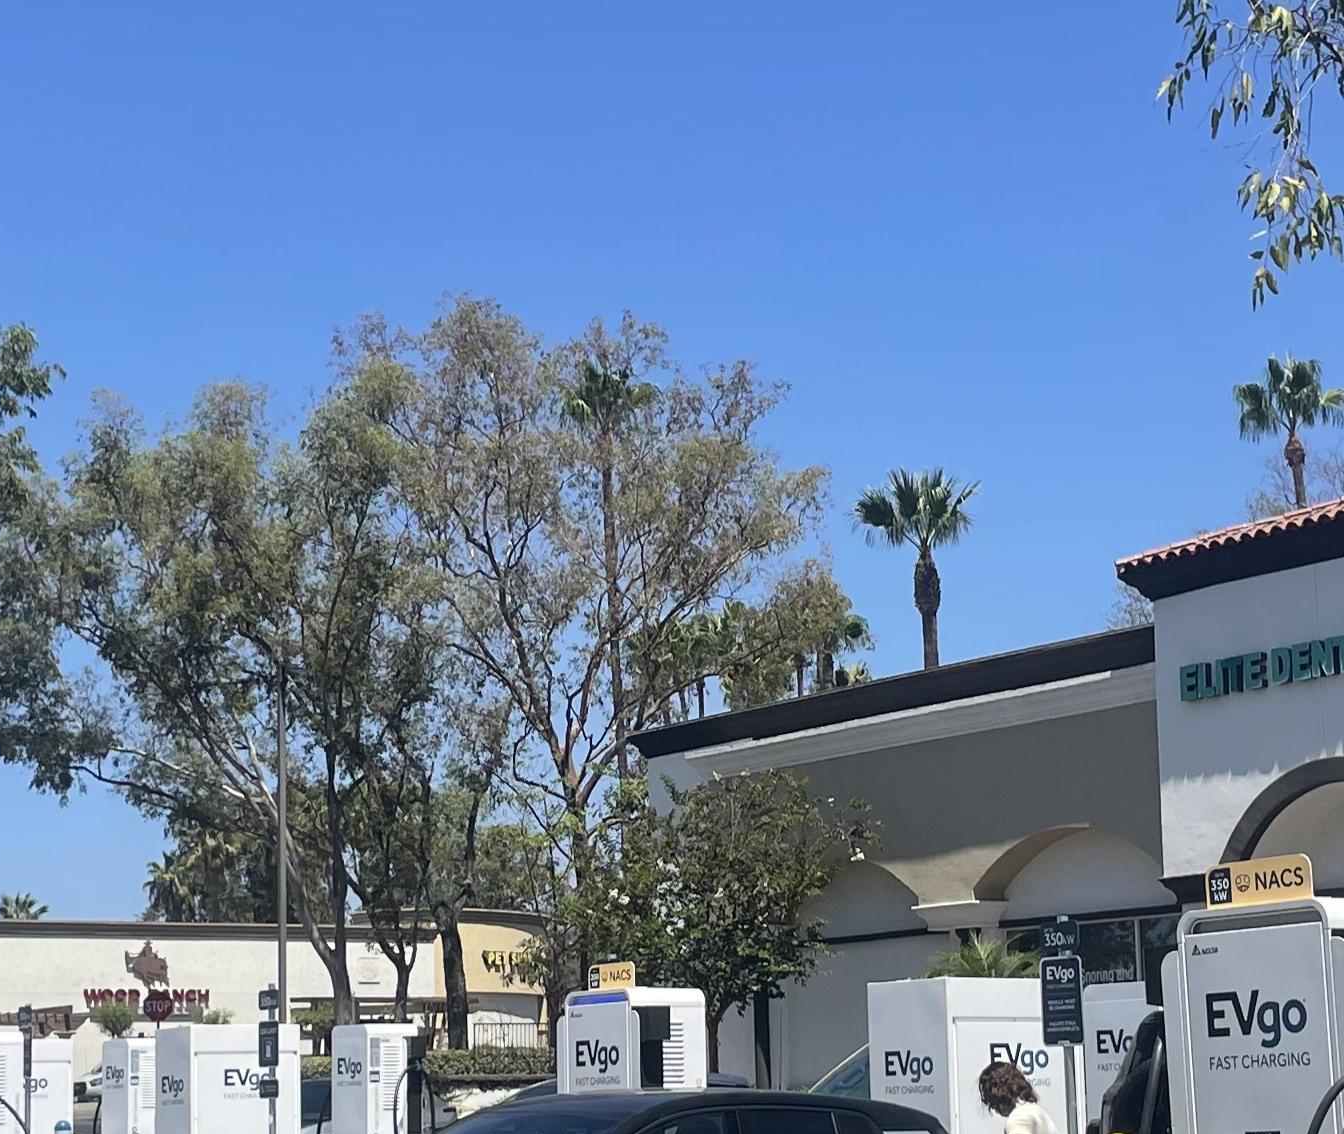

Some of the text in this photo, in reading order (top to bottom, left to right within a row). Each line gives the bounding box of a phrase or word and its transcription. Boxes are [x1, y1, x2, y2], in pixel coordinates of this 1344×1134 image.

[1180, 652, 1268, 701] ELITE
[1210, 878, 1230, 891] 350
[1255, 867, 1304, 891] NACS
[1214, 891, 1227, 901] kW
[1044, 932, 1075, 947] 350kW
[609, 968, 632, 982] NACS
[1046, 966, 1075, 983] EVgo
[1115, 966, 1134, 981] and
[84, 989, 140, 1003] WOOD
[145, 1001, 171, 1013] STOP
[1206, 990, 1307, 1048] EVgo
[1096, 1029, 1134, 1054] EV
[575, 1039, 620, 1073] EVgo
[990, 1042, 1049, 1075] EVgo
[1209, 1052, 1311, 1071] FAST CHARGING
[106, 1065, 125, 1083] EVgo
[337, 1057, 363, 1079] EVgo
[885, 1050, 934, 1083] EVgo
[23, 1077, 48, 1093] go
[161, 1075, 184, 1098] EVgo
[575, 1075, 621, 1086] FAST CHARGING
[885, 1085, 935, 1094] FAST CHARGING
